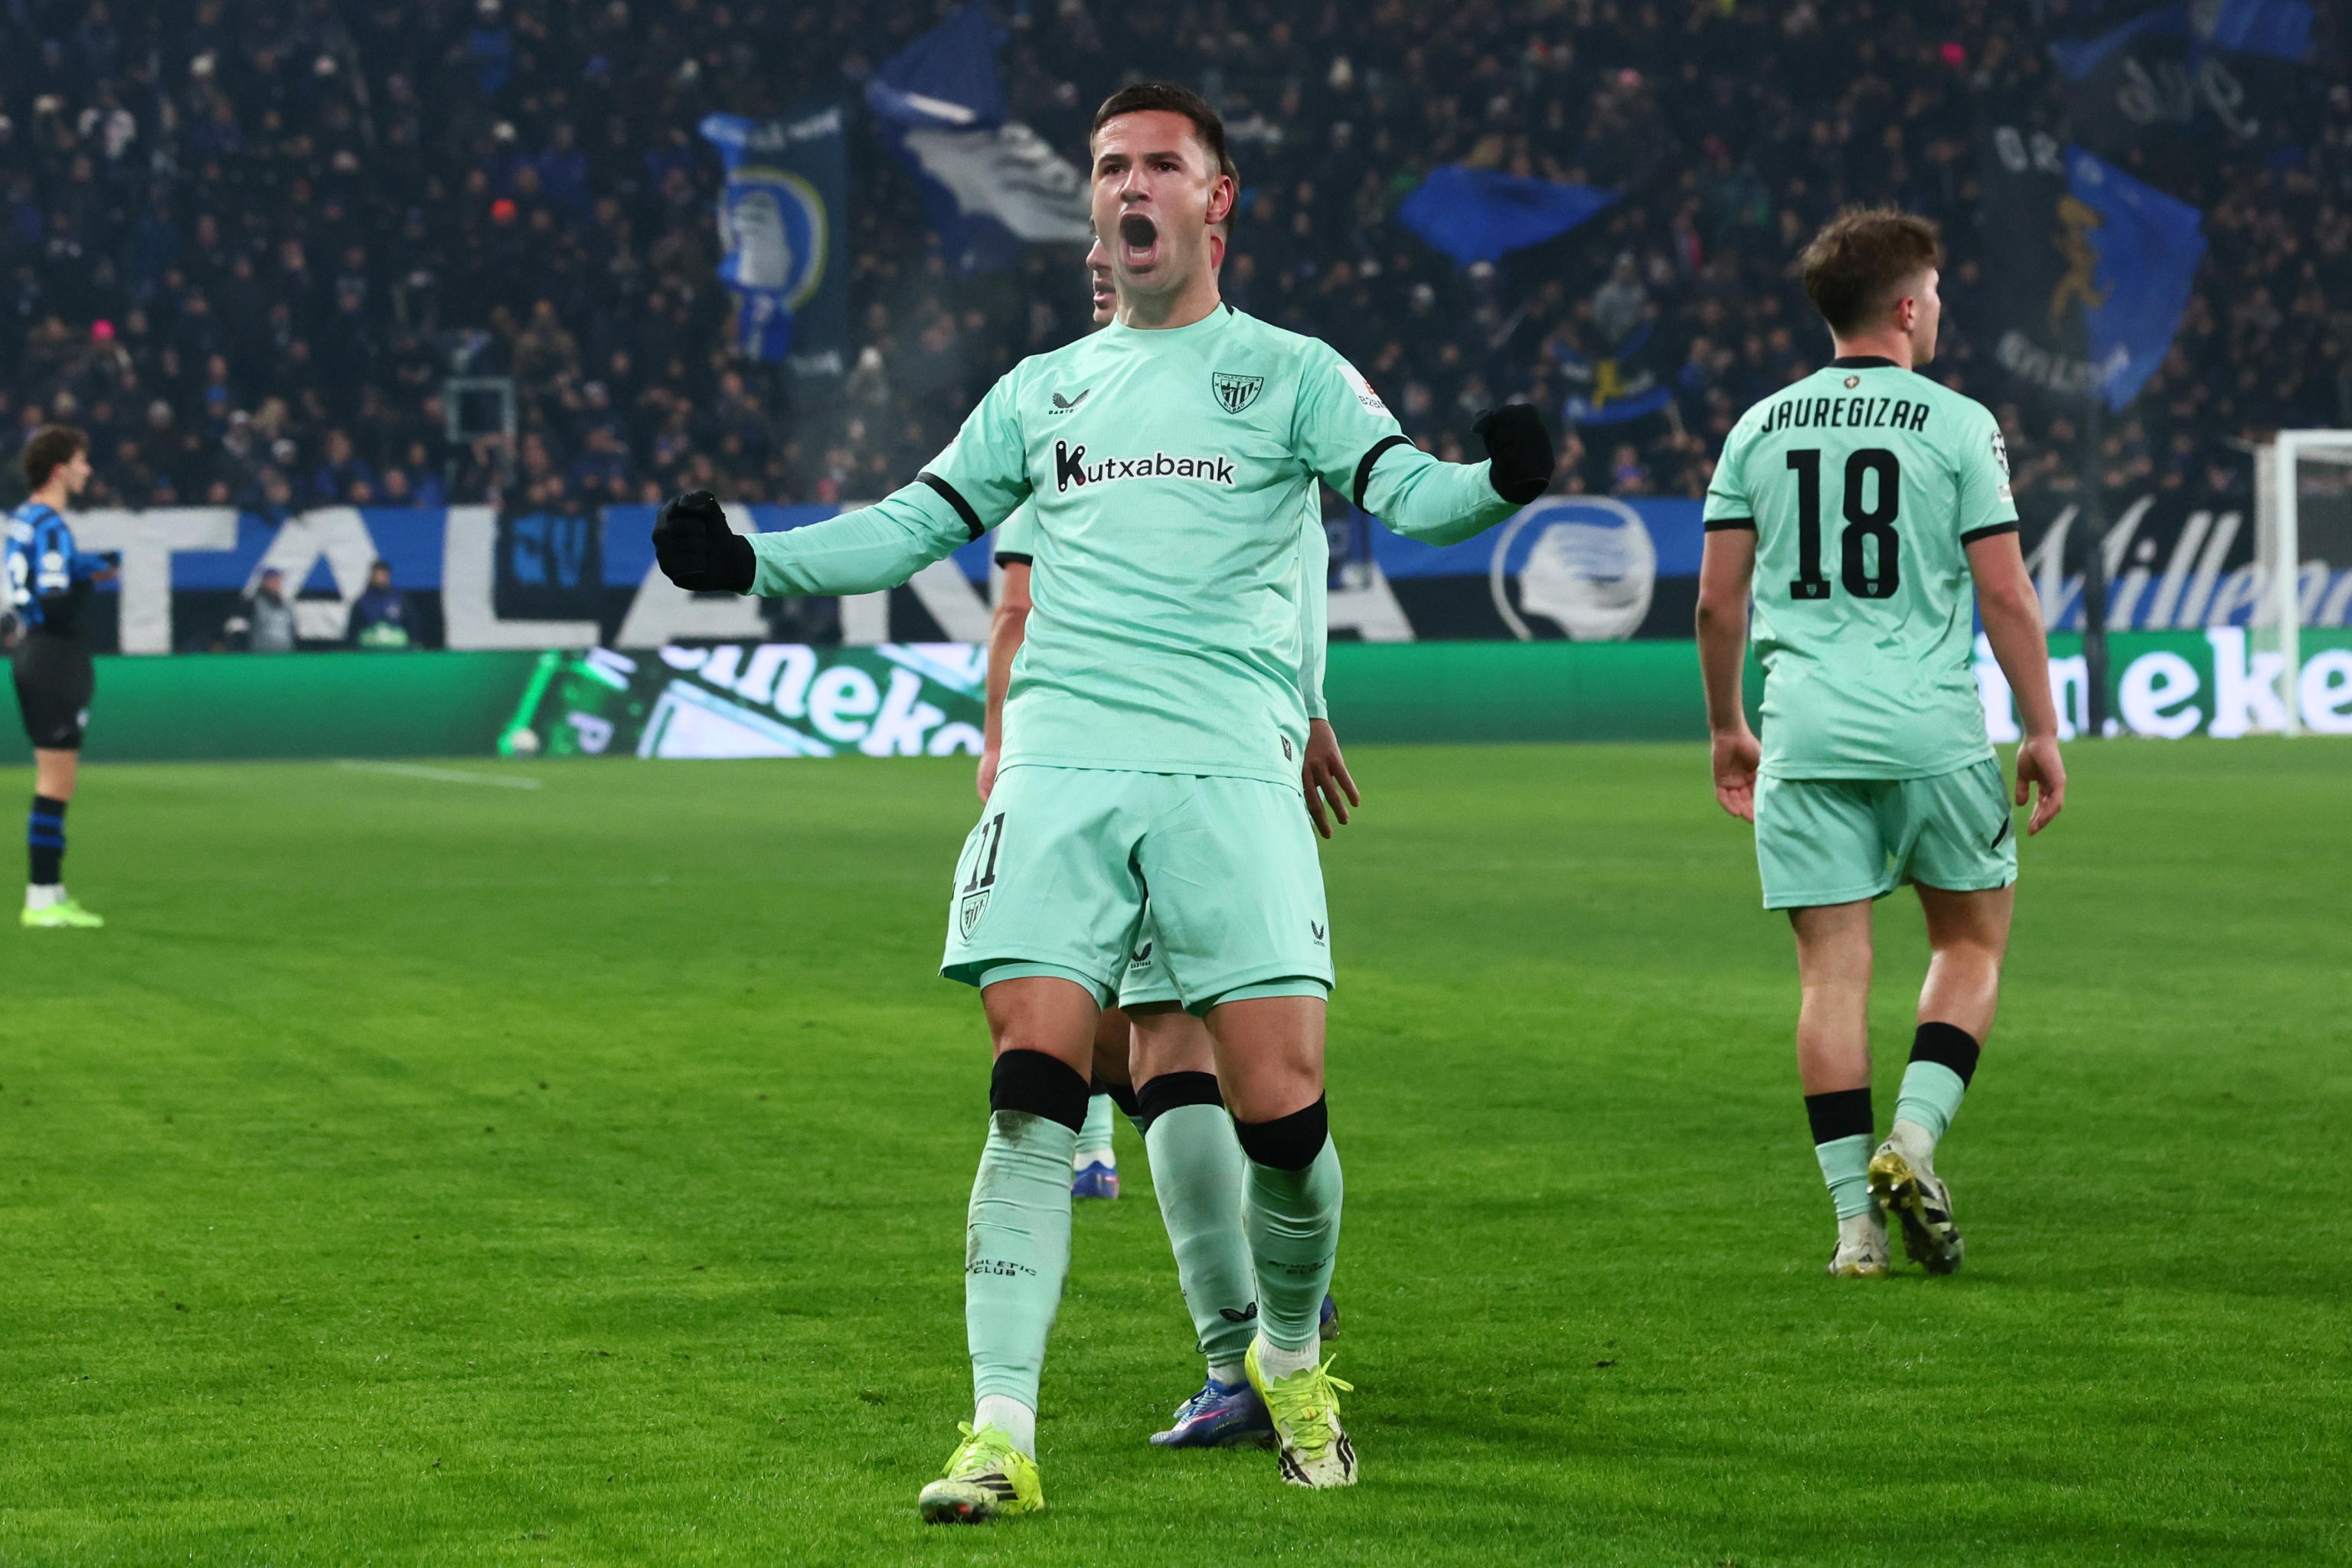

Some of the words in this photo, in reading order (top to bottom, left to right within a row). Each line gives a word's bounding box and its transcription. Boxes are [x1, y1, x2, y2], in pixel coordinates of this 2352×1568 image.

[1762, 397, 1930, 433] JAUREGIZAR
[1056, 440, 1235, 492] Kutxabank
[1786, 448, 1900, 600] 18
[962, 812, 1006, 893] 11
[973, 1266, 1016, 1277] CLUB
